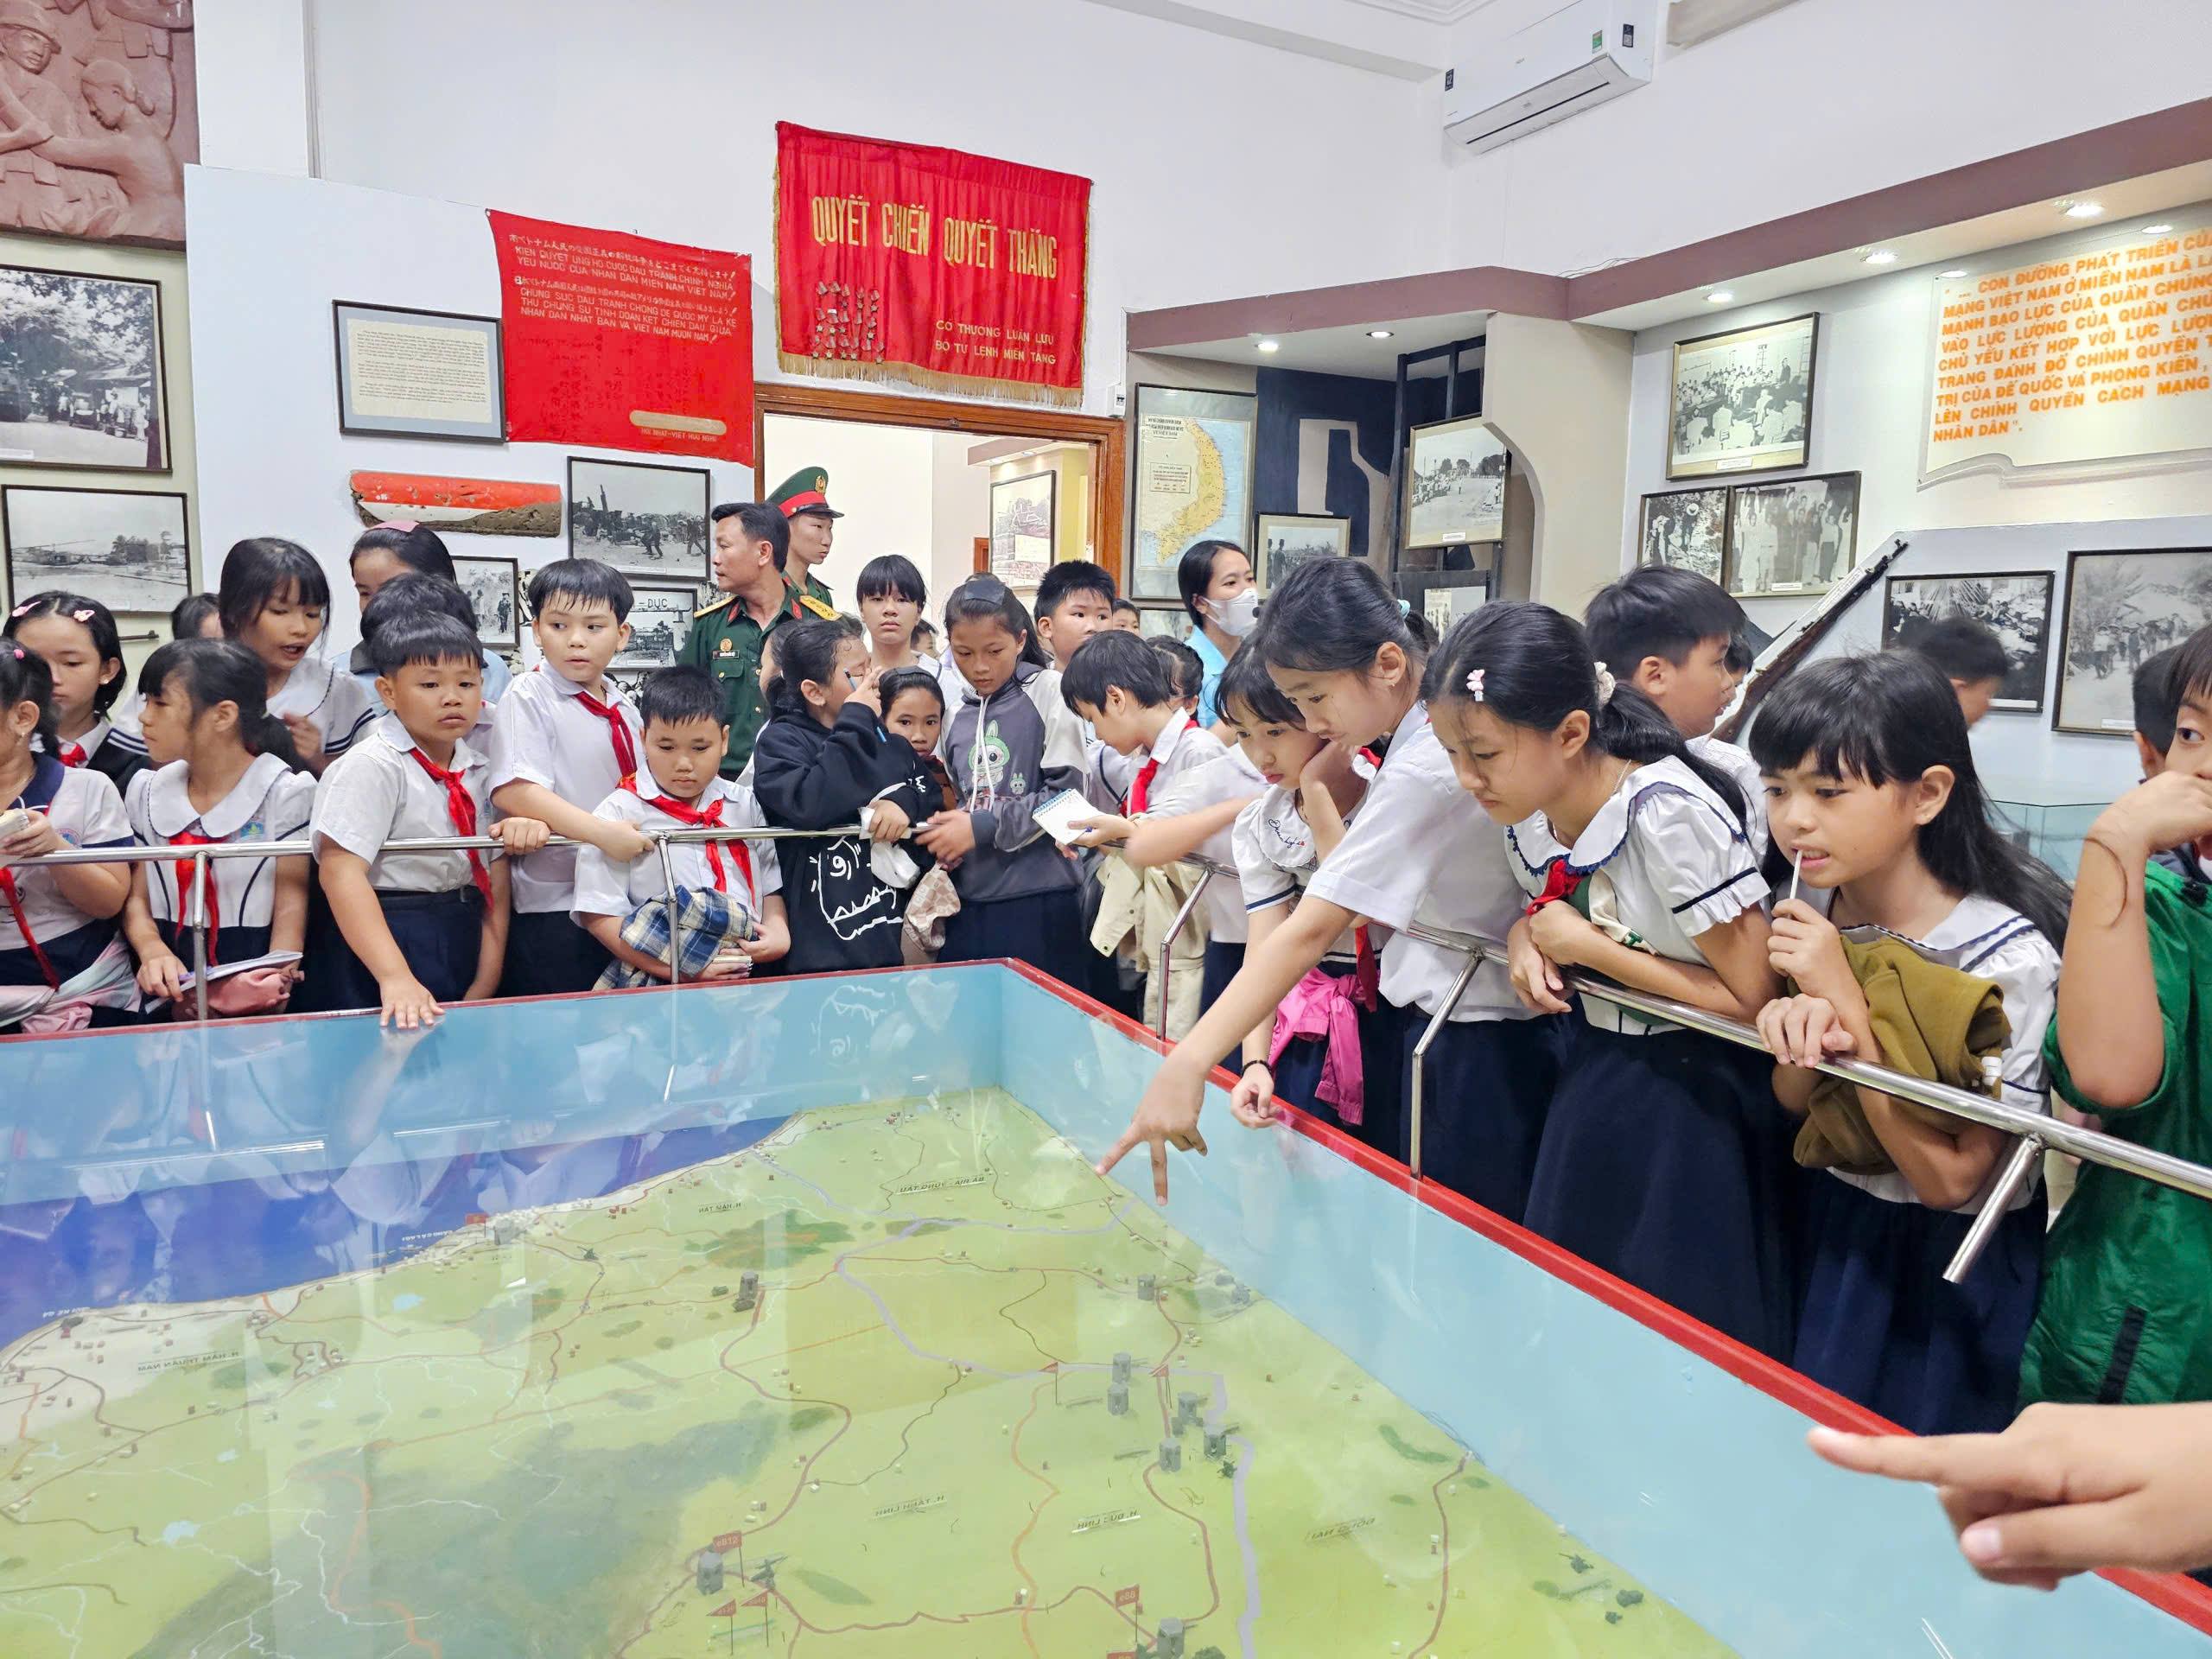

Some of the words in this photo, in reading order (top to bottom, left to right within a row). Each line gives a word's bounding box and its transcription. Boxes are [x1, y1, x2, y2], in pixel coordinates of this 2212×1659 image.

[811, 194, 870, 246] QUYẾT
[881, 204, 930, 256] CHIẾN
[944, 218, 998, 270] QUYẾT
[1007, 228, 1057, 278] THẮNG
[515, 245, 536, 257] KIEN
[539, 250, 569, 262] QUYET
[572, 255, 590, 266] UNG
[592, 258, 604, 268] HO
[607, 261, 628, 272] CUOC
[630, 265, 646, 276] DAU
[649, 270, 677, 281] TRANH
[679, 274, 703, 286] CHINH
[709, 279, 734, 291] NGHIA
[518, 256, 537, 267] YEU
[539, 260, 566, 272] NUOC
[569, 264, 588, 275] CUA
[592, 269, 616, 280] NHAN
[620, 272, 639, 283] DAN
[641, 277, 664, 289] MIEN
[666, 282, 685, 292] NAM
[687, 286, 707, 296] VIET
[1978, 276, 2009, 293] CON
[2075, 251, 2120, 273] PHÁT
[520, 287, 550, 299] CHUNG
[556, 291, 574, 302] SUC
[577, 295, 594, 305] DAU
[598, 297, 627, 309] TRANH
[630, 302, 658, 315] CHONG
[674, 310, 696, 321] QUOC
[698, 314, 709, 323] MY
[712, 316, 723, 325] LA
[726, 318, 737, 327] KE
[1943, 299, 1985, 319] MẠNG
[1990, 290, 2023, 309] VIỆT
[2026, 283, 2061, 302] NAM
[2126, 262, 2164, 283] NAM
[520, 296, 539, 308] THU
[543, 300, 575, 312] CHUNG
[579, 304, 591, 315] SU
[594, 307, 616, 318] TINH
[620, 310, 642, 322] DOAN
[643, 315, 658, 325] KET
[662, 317, 686, 328] CHIEN
[690, 321, 705, 331] DAU
[709, 324, 732, 336] GIUA
[520, 307, 545, 318] NHAN
[549, 310, 567, 321] DAN
[570, 313, 593, 324] NHAT
[597, 317, 616, 327] BAN
[620, 320, 630, 329] VA
[633, 323, 651, 334] VIET
[653, 326, 670, 336] NAM
[671, 328, 692, 340] MUON
[1937, 371, 1986, 389] TRANG
[2091, 365, 2151, 385] PHONG
[1935, 409, 1961, 425] LÊN
[2157, 375, 2209, 397] MẠNG
[1933, 424, 1974, 442] NHÂN
[1978, 419, 2010, 436] DÂN
